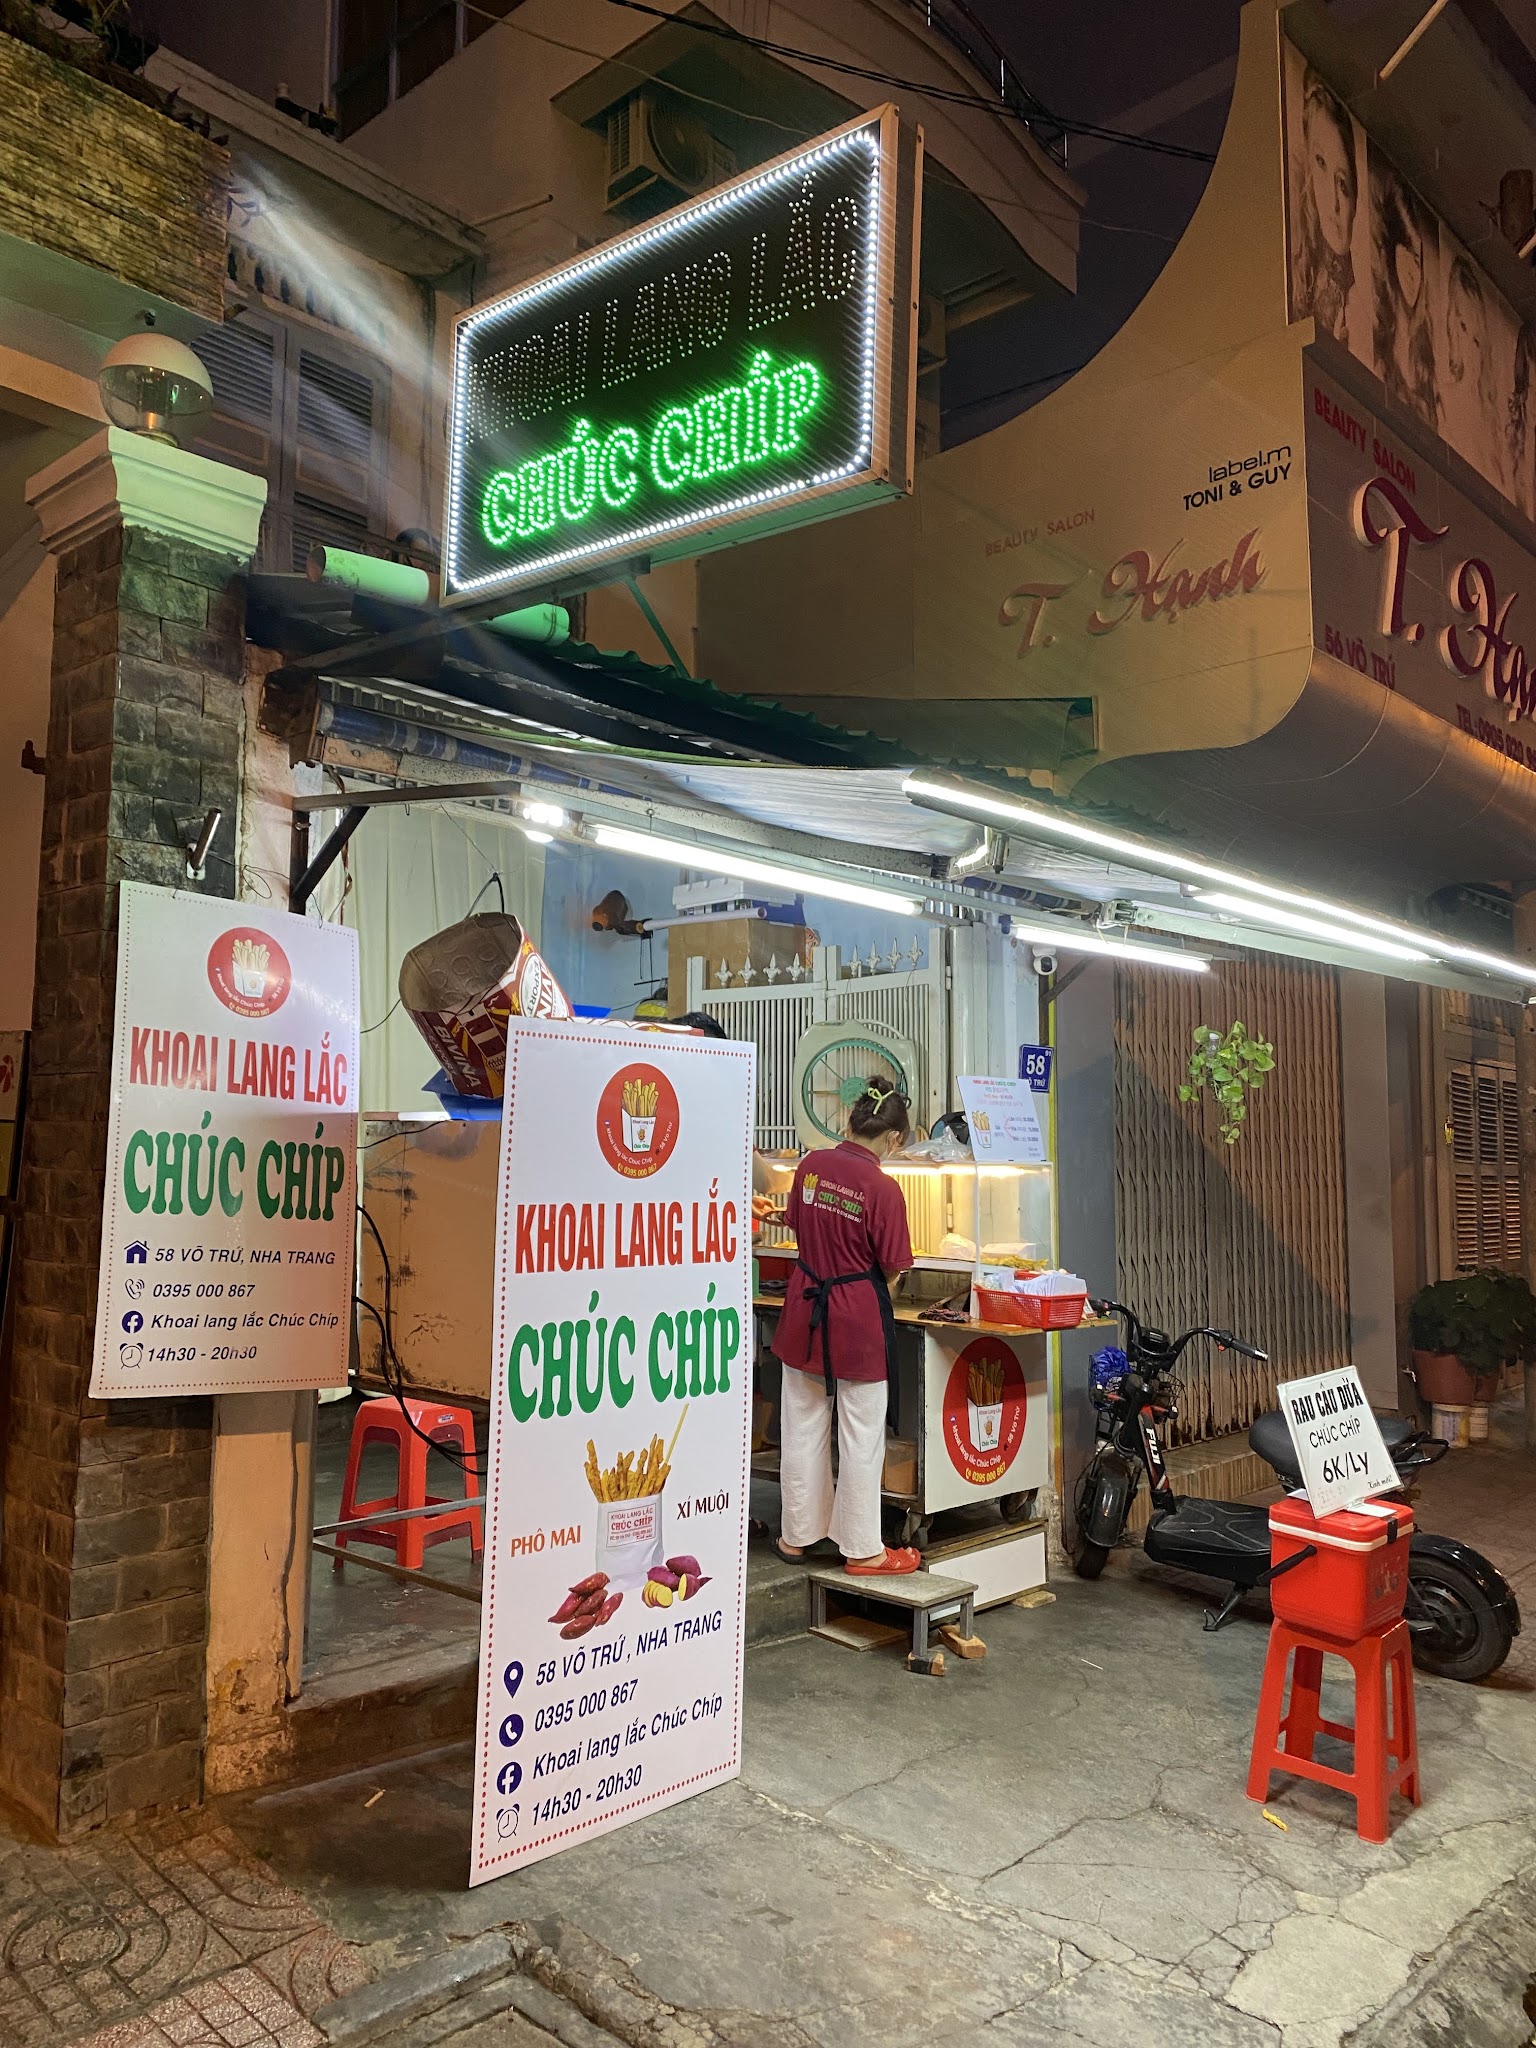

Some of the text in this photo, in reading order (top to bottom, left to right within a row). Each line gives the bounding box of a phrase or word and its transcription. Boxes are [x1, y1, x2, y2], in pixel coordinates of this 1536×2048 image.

[602, 250, 732, 389] LANG
[747, 171, 858, 331] LẮC
[482, 349, 821, 546] CHÚC CHÍP
[1209, 445, 1292, 483] label.m
[1314, 387, 1417, 496] BEAUTY SALON
[1183, 462, 1292, 511] TONI & GUY
[984, 508, 1096, 557] BEAUTY SALON
[527, 960, 540, 1015] EXPORT
[129, 1026, 348, 1106] KHOAI LANG LẮC
[433, 1025, 481, 1087] BIVINA
[1026, 1054, 1045, 1076] 58
[123, 1111, 345, 1222] CHÚC CHÍP
[515, 1178, 737, 1274] KHOAI LANG LẮC
[155, 1249, 174, 1262] 58
[181, 1245, 203, 1262] VÕ
[250, 1250, 282, 1264] NHA
[287, 1251, 336, 1264] TRANG
[153, 1284, 255, 1298] 0395 000 867
[151, 1310, 339, 1330] Khoai lang lắc Chúc Chíp
[148, 1348, 196, 1362] 14h30
[211, 1346, 257, 1360] 20h30
[508, 1282, 740, 1423] CHÚC CHÍP
[1291, 1377, 1364, 1425] RAU CÂU DỪA
[1309, 1414, 1361, 1448] CHÚC CHÍP
[972, 1471, 986, 1483] 0395
[986, 1471, 997, 1482] 000
[611, 1515, 653, 1531] CHÚC CHÍP
[677, 1492, 730, 1520] XÍ MUỘI
[510, 1527, 546, 1558] PHÔ
[551, 1525, 582, 1550] MAI
[536, 1660, 556, 1686] 58
[563, 1646, 586, 1678] VÕ
[636, 1627, 668, 1656] NHA
[674, 1610, 722, 1644] TRANG
[535, 1679, 638, 1732] 0395 000 867
[533, 1693, 722, 1780] Khoai lang lắc Chúc Chíp
[533, 1787, 581, 1826] 14h30
[595, 1764, 642, 1802] 20h30
